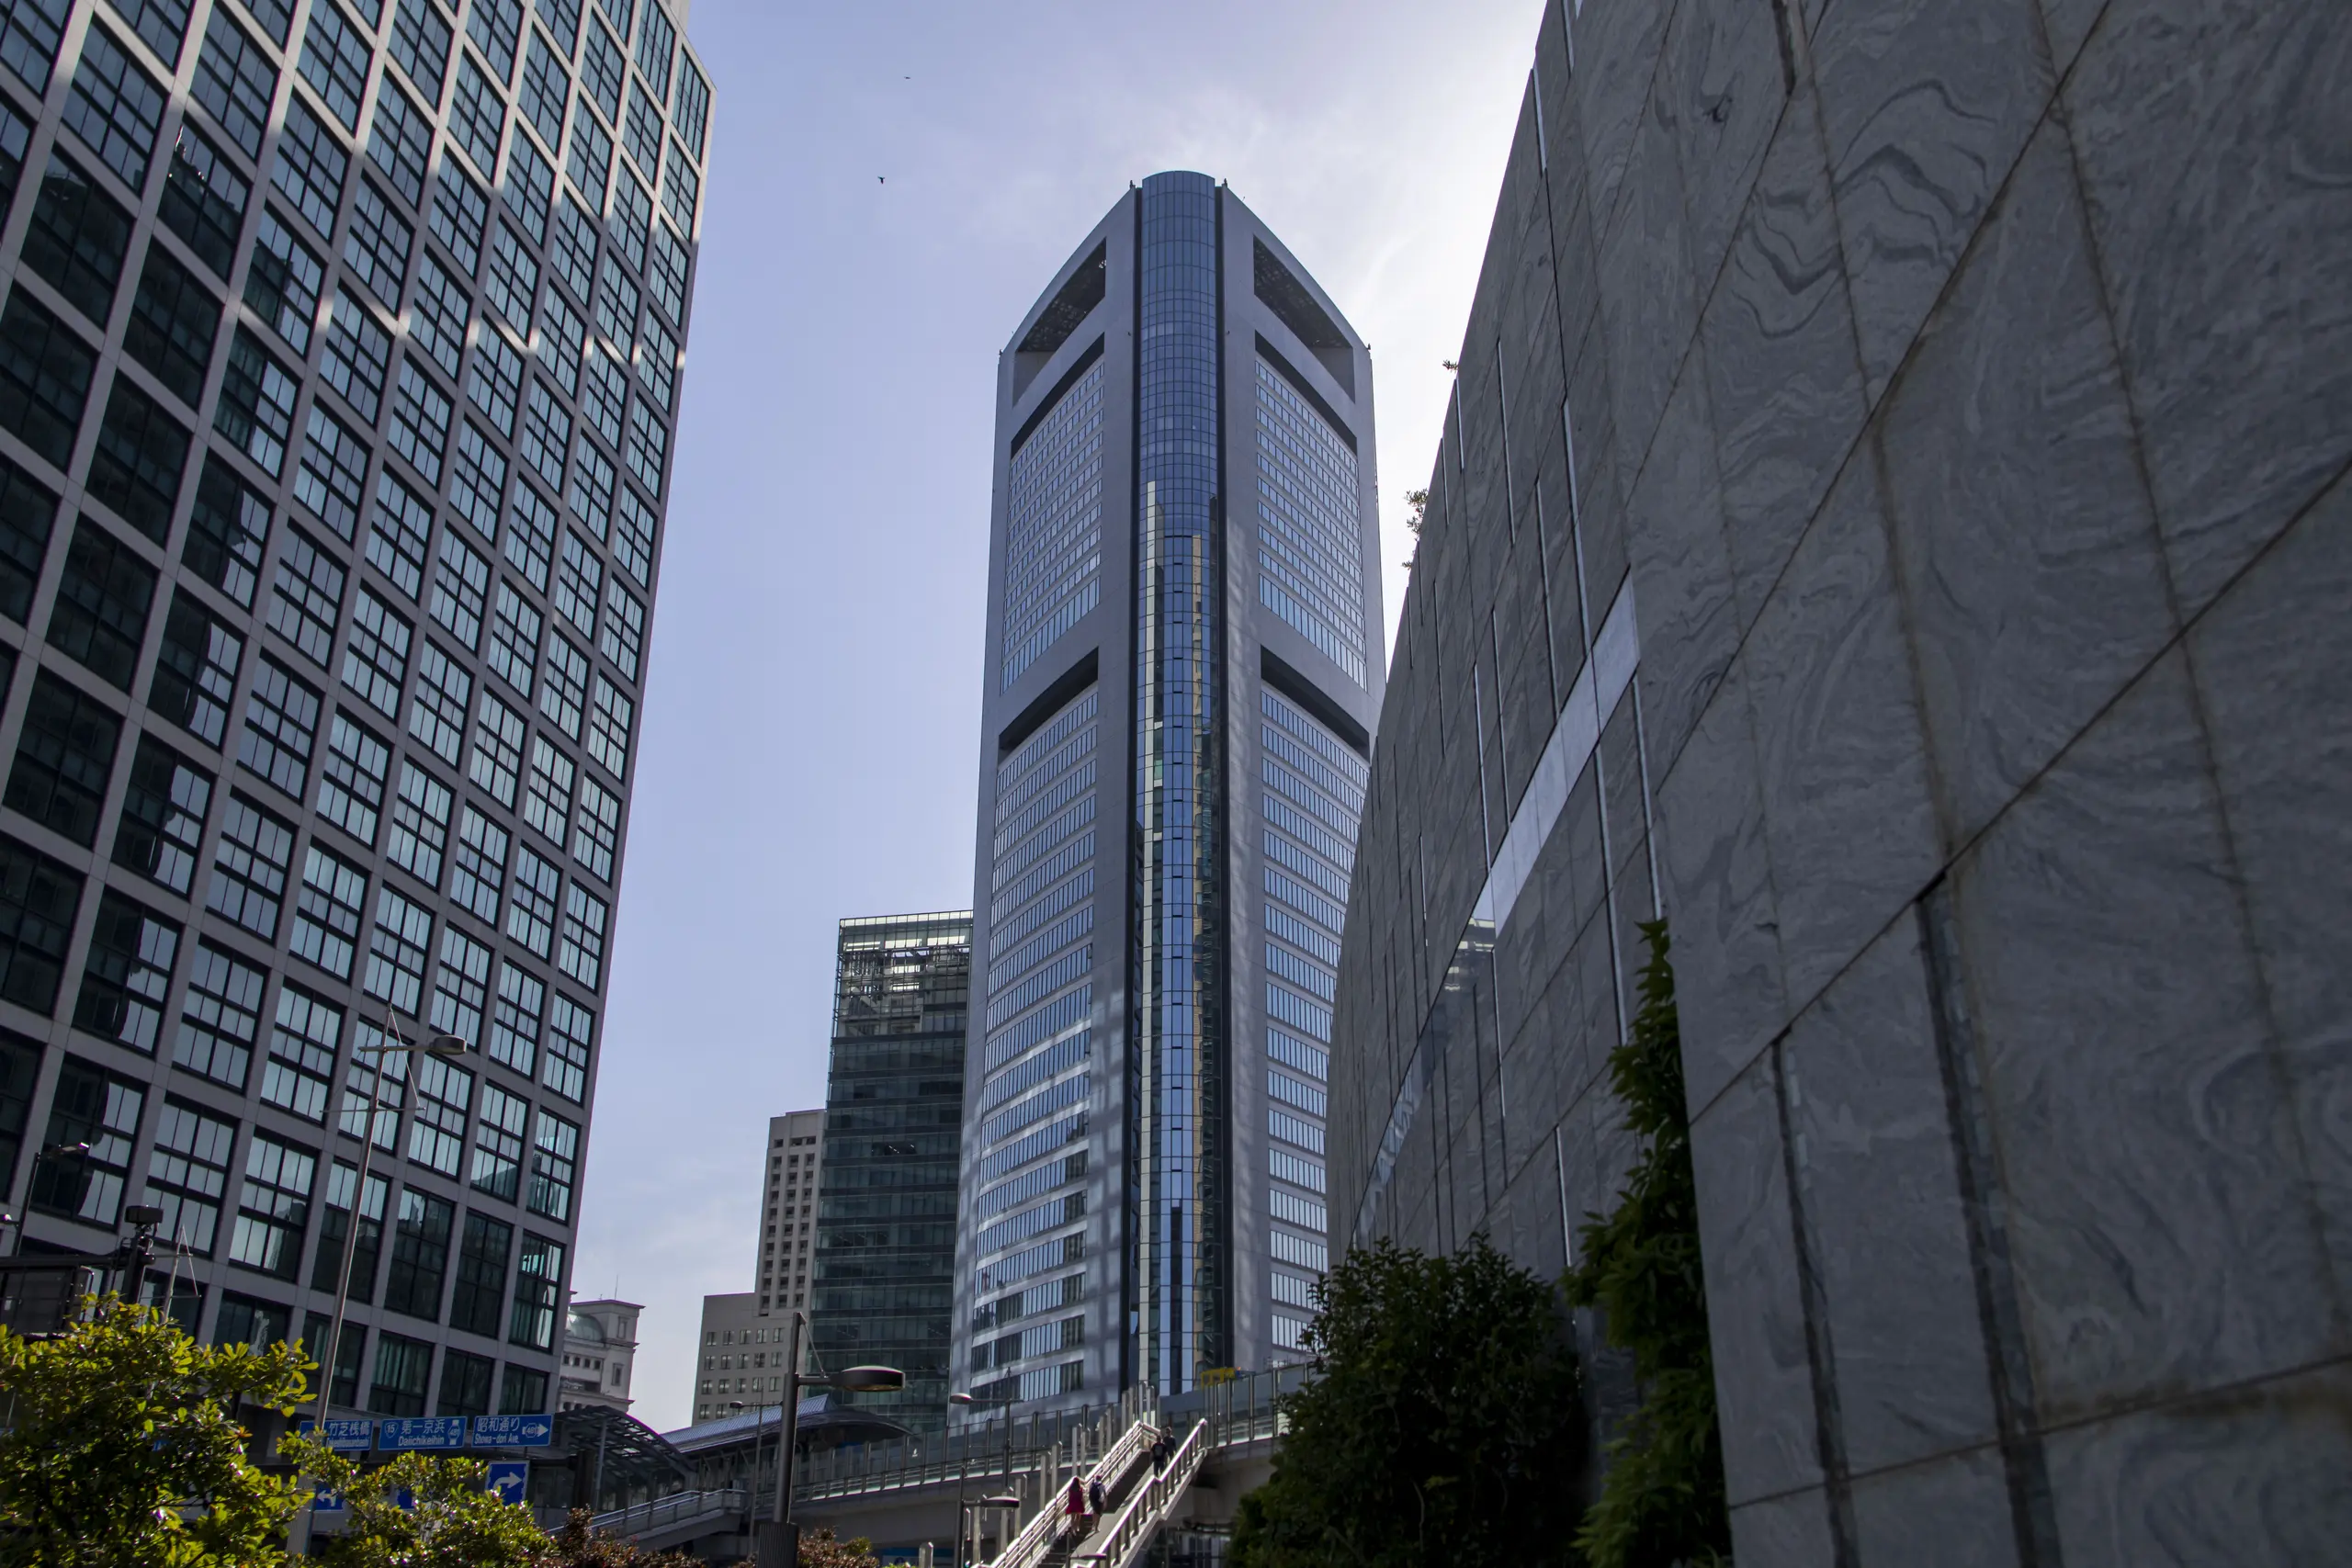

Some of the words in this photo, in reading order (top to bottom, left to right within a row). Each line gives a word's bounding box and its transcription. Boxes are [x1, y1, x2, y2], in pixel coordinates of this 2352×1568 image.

[387, 1424, 395, 1433] 15
[401, 1419, 445, 1435] 第一京浜
[478, 1416, 520, 1432] 昭和通り
[398, 1436, 445, 1447] Daiichikeihin
